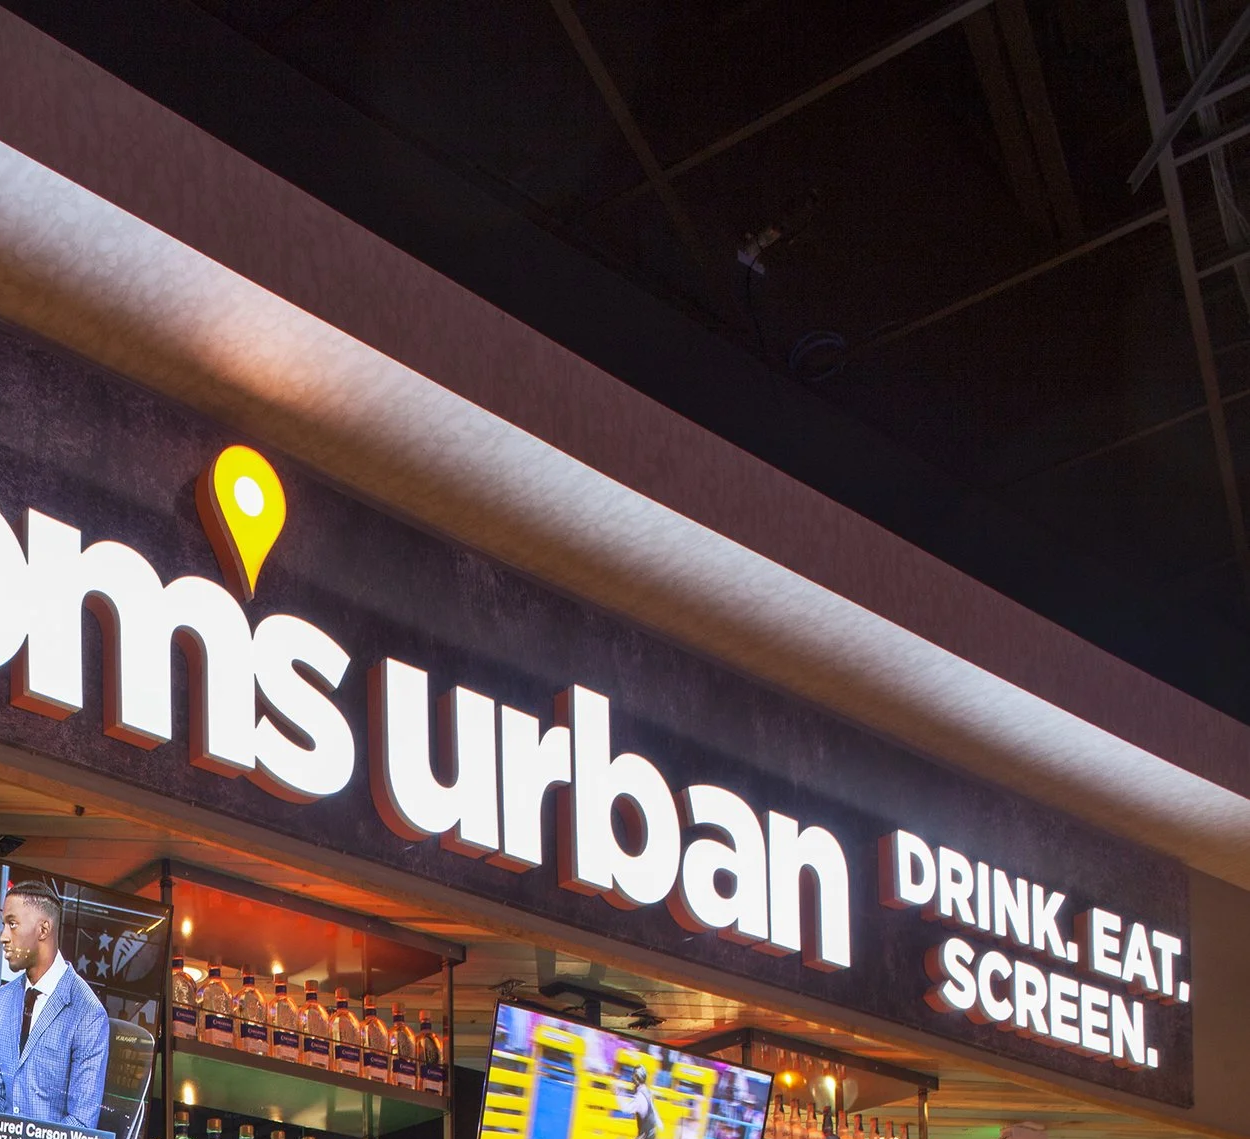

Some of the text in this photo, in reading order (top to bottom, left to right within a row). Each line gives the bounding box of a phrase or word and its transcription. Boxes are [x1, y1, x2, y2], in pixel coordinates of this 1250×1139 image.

[386, 657, 851, 968] urban
[895, 829, 1190, 1003] DRINK. EAT.
[942, 937, 1159, 1068] SCREEN.
